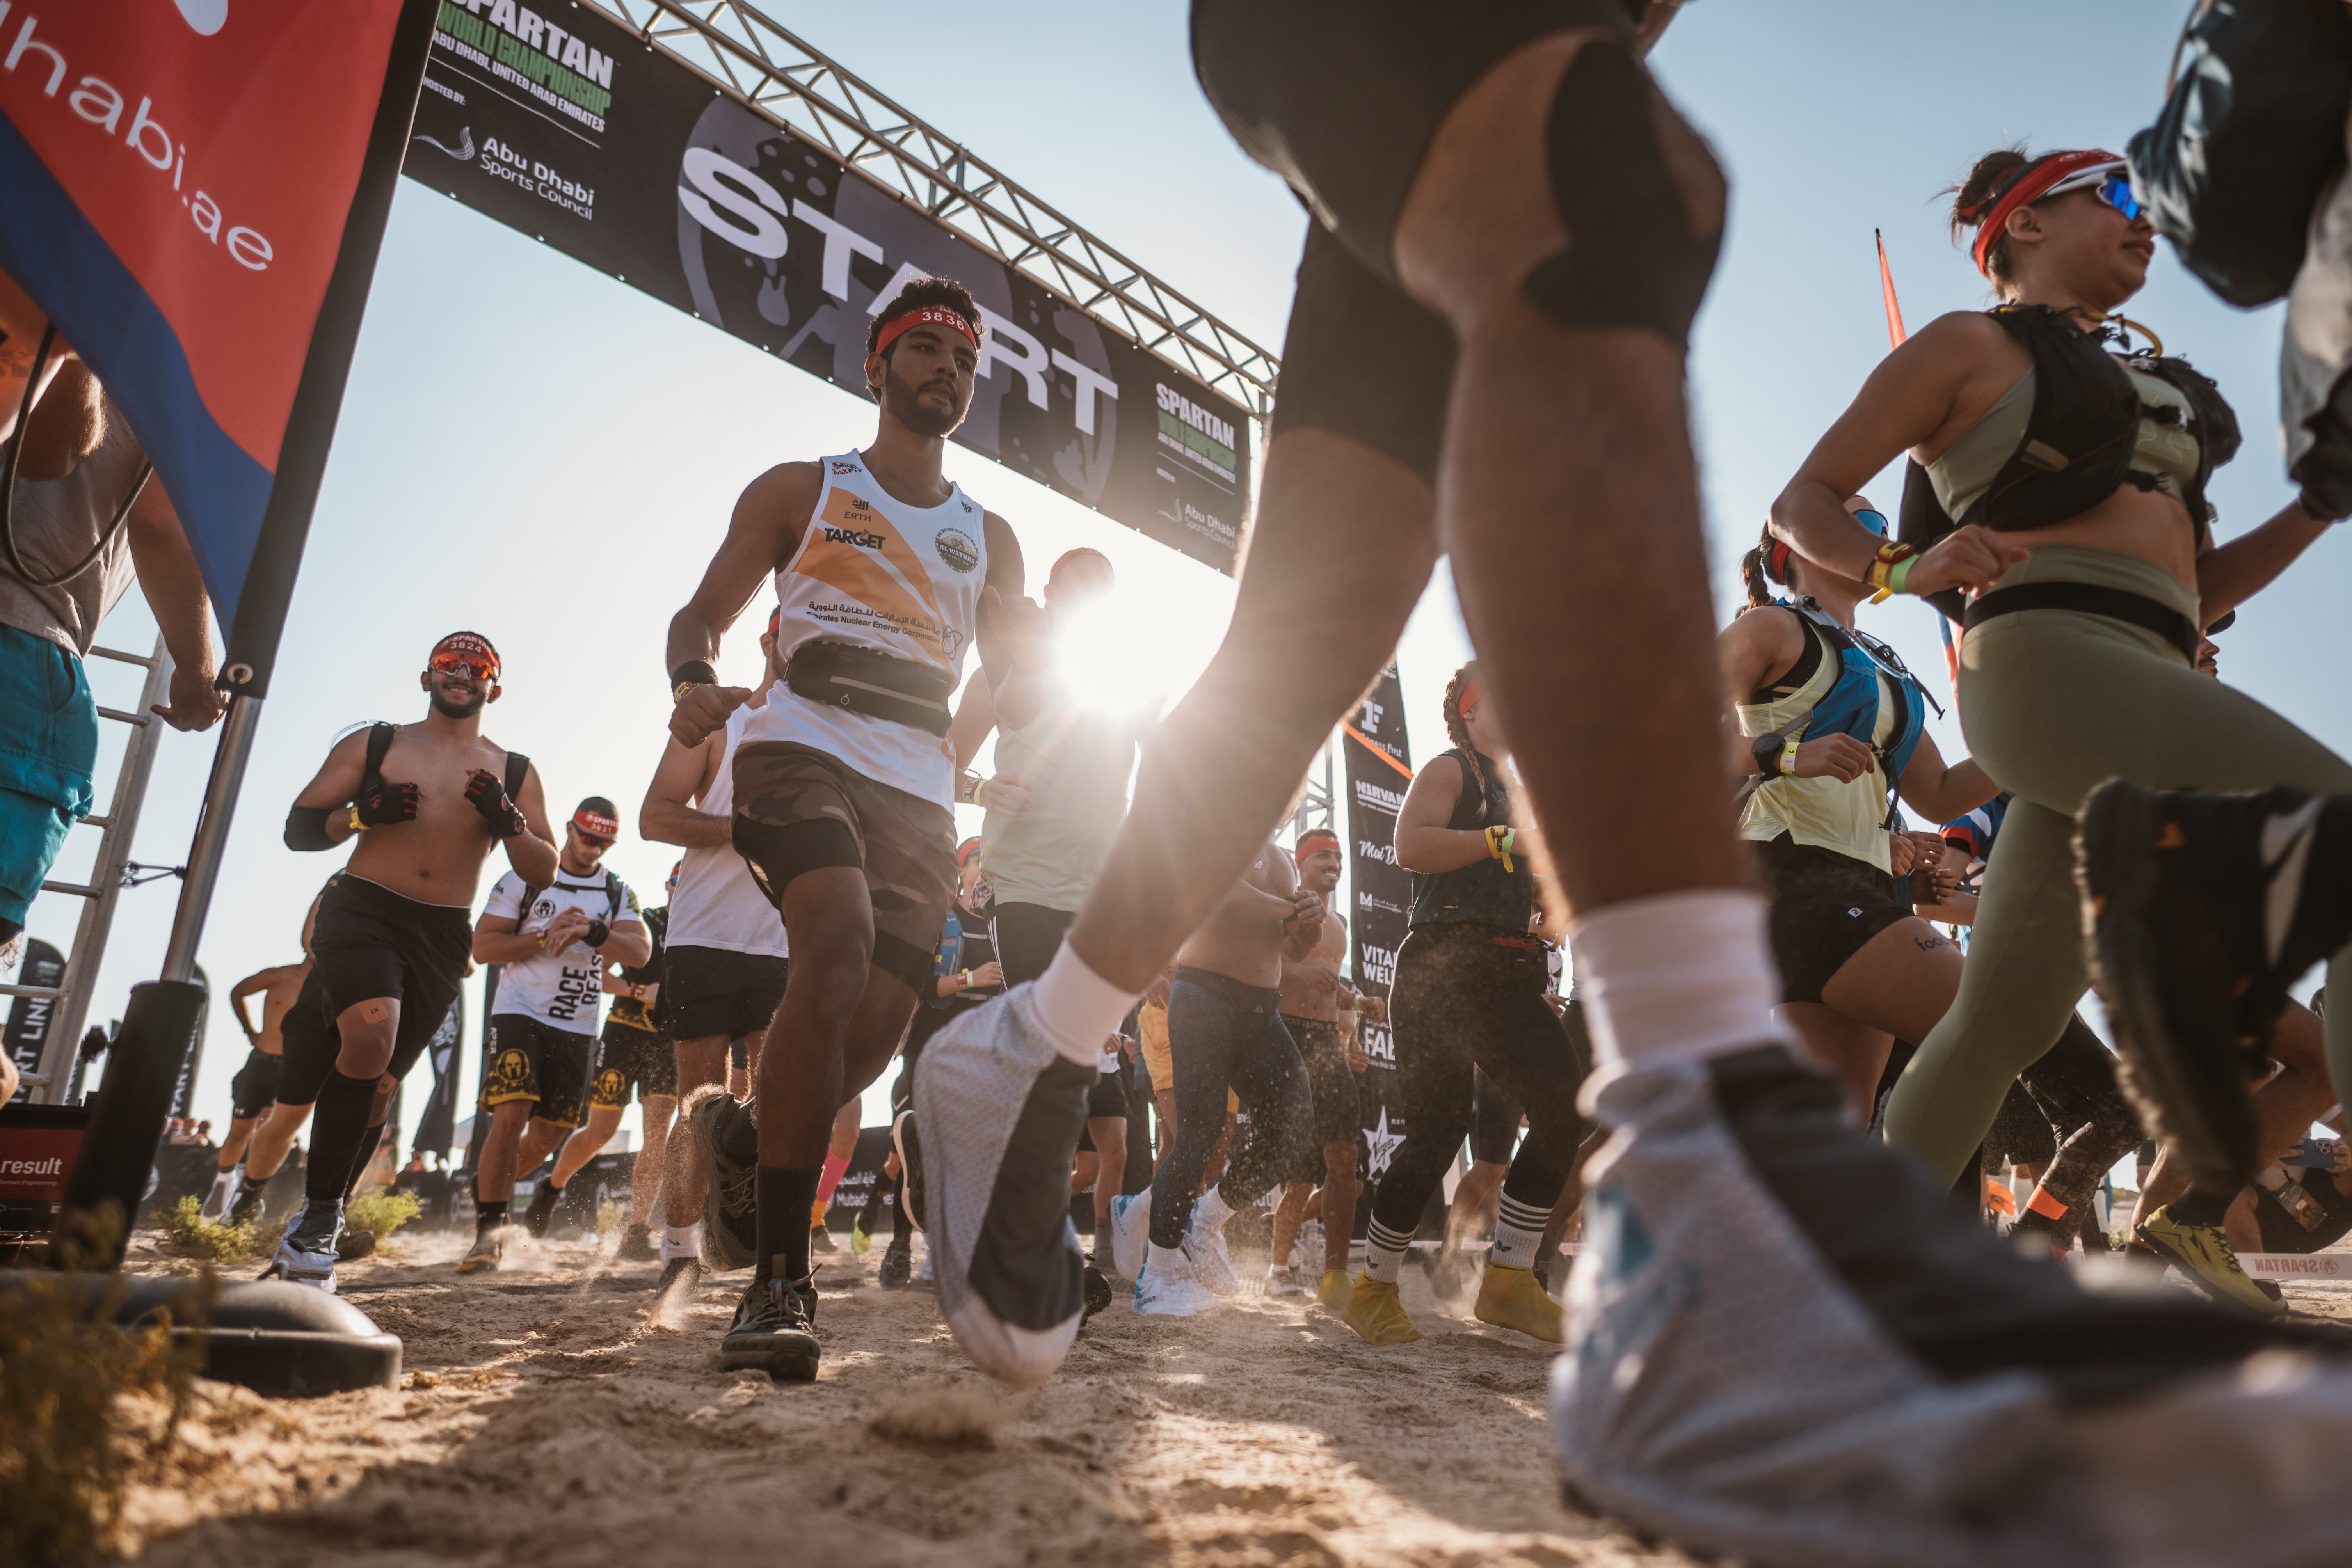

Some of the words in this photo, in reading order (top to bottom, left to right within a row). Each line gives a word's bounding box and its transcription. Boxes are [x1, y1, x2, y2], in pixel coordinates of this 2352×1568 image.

[437, 0, 498, 56] WORLD
[496, 33, 612, 117] CHAMPIONSHIP
[452, 0, 614, 90] ARTAN
[423, 76, 453, 99] HOSTED
[433, 29, 455, 51] ABU
[455, 41, 491, 72] DHABI,
[492, 60, 530, 91] UNITED
[530, 82, 557, 107] ARAB
[557, 97, 605, 133] EMIRATES
[0, 0, 273, 270] habi.ae
[479, 154, 534, 192] Sports
[538, 183, 592, 221] Council
[483, 137, 527, 170] Abu
[534, 162, 595, 206] Dhabi
[922, 312, 965, 330] 3836
[1156, 382, 1235, 451] SPARTAN
[844, 511, 871, 522] ERTH
[1185, 504, 1205, 523] Abu
[1207, 515, 1235, 539] Dhabi
[824, 527, 886, 550] TARGET
[949, 548, 975, 564] WATHBA
[806, 611, 839, 622] Emirates
[841, 616, 871, 627] Nuclear
[873, 621, 900, 634] Energy
[902, 627, 939, 645] Corporation
[451, 641, 482, 653] 3824
[591, 824, 612, 833] 3831
[1359, 840, 1385, 861] Mai
[548, 966, 587, 1021] RACE
[0, 1157, 62, 1175] result
